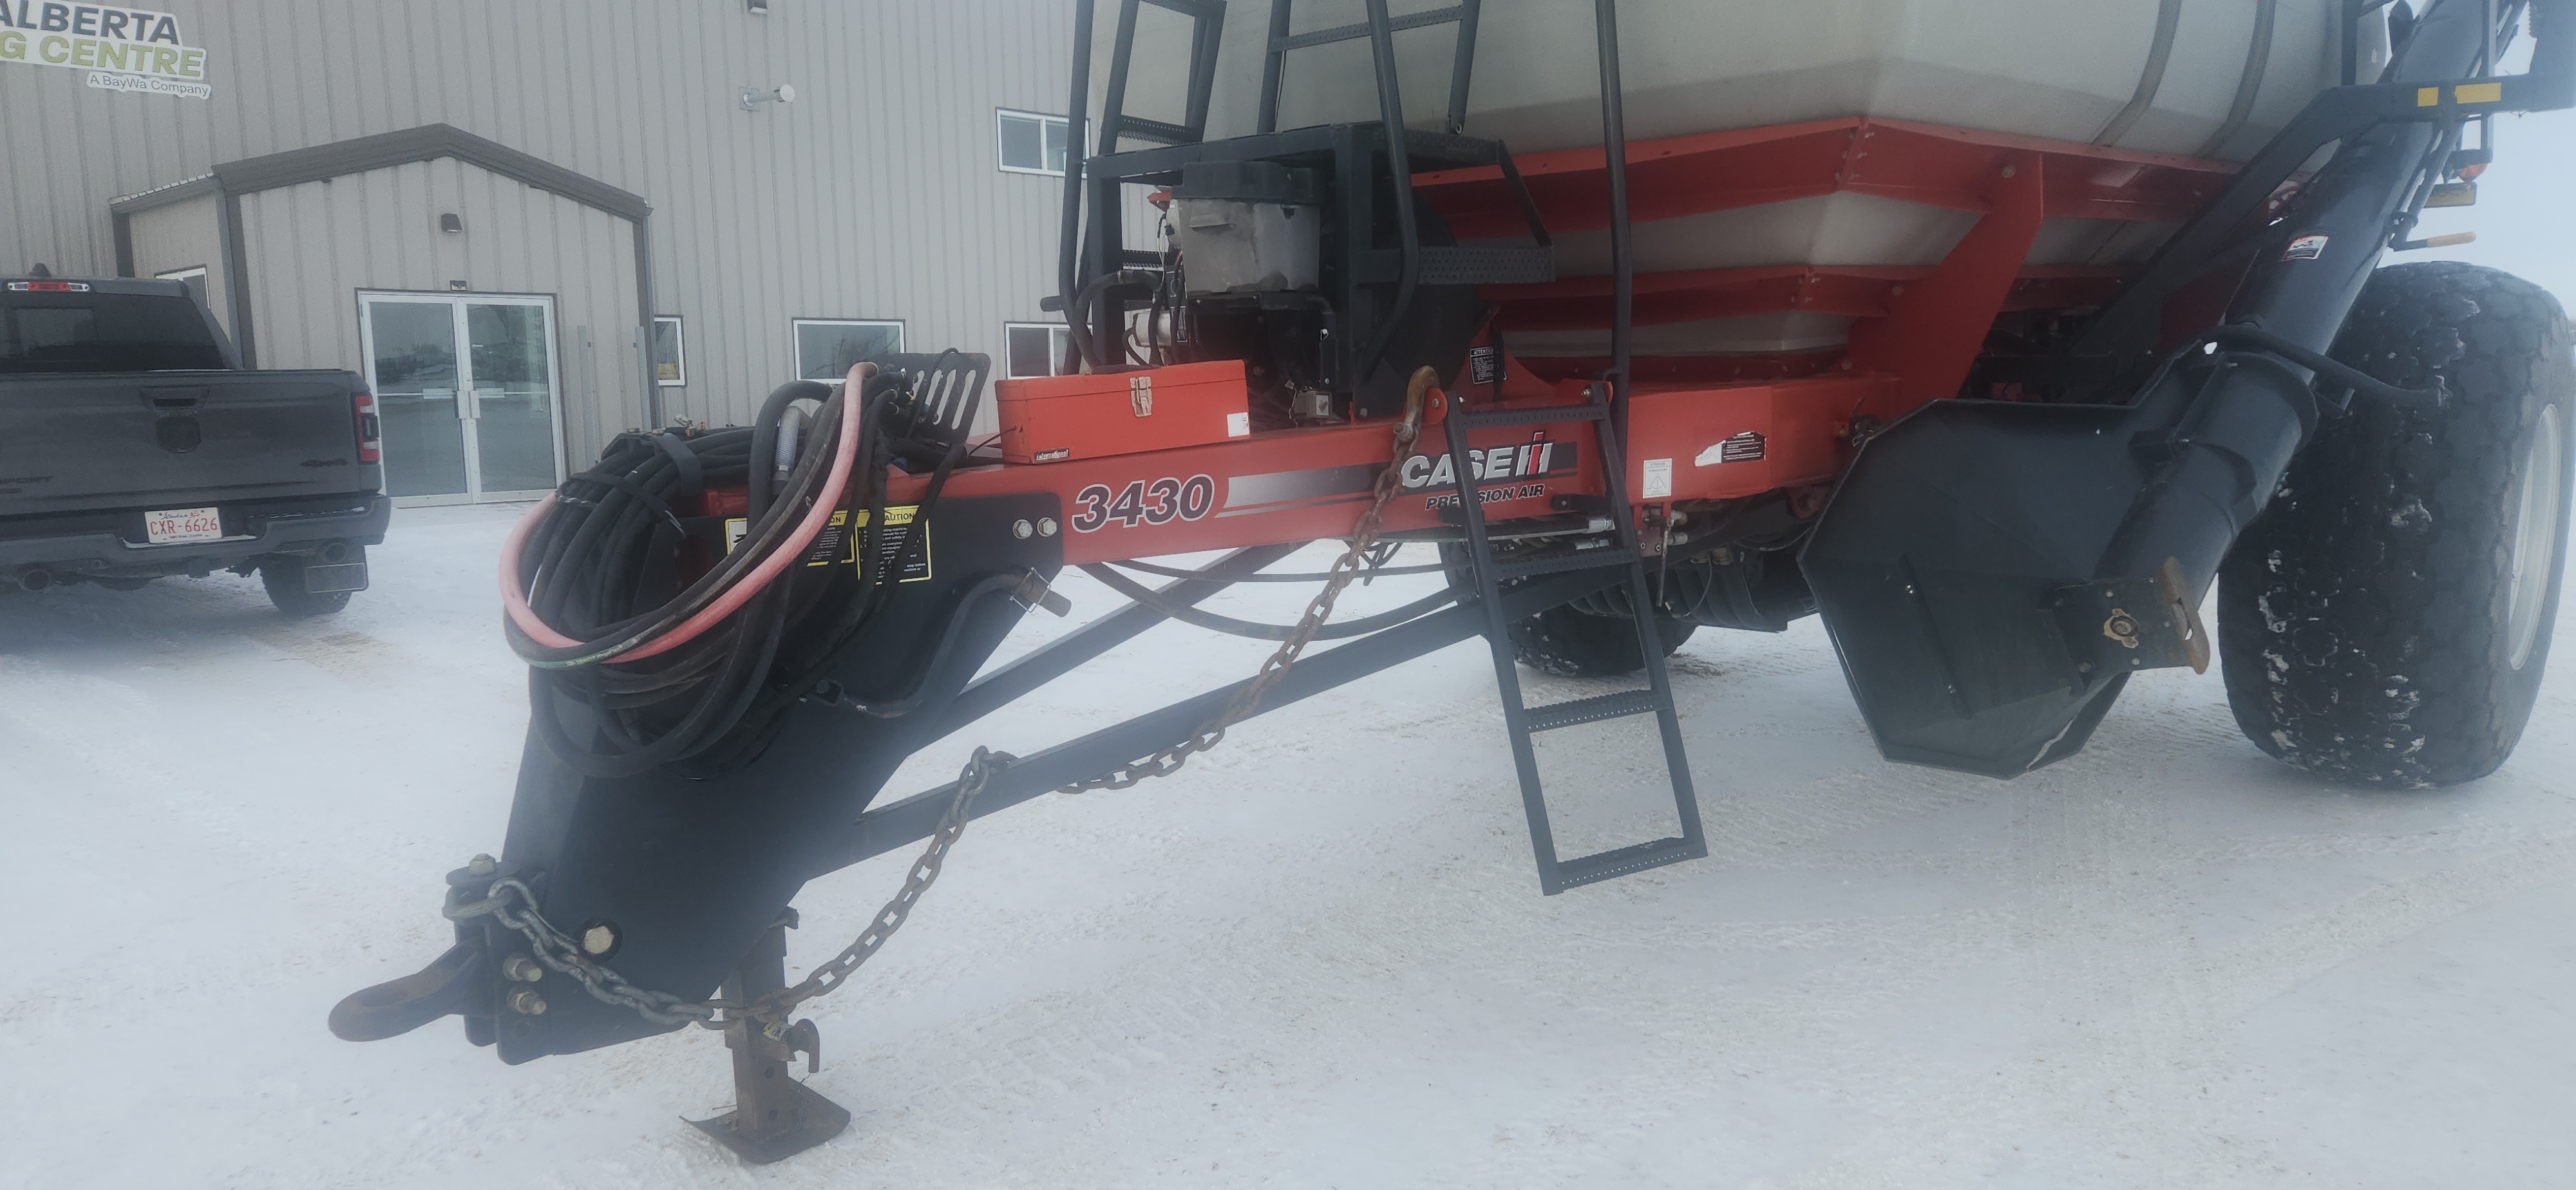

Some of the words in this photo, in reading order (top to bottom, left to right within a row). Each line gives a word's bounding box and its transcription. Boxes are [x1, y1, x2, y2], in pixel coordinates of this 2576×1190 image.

[39, 35, 204, 77] CENTRE
[90, 74, 100, 85] A
[103, 75, 147, 90] BayWa
[151, 79, 209, 97] Company
[1072, 473, 1215, 534] 3430
[1425, 487, 1515, 511] PRESION
[1516, 484, 1545, 500] AIR
[150, 517, 217, 535] CXR-6626
[884, 513, 914, 521] AUTION
